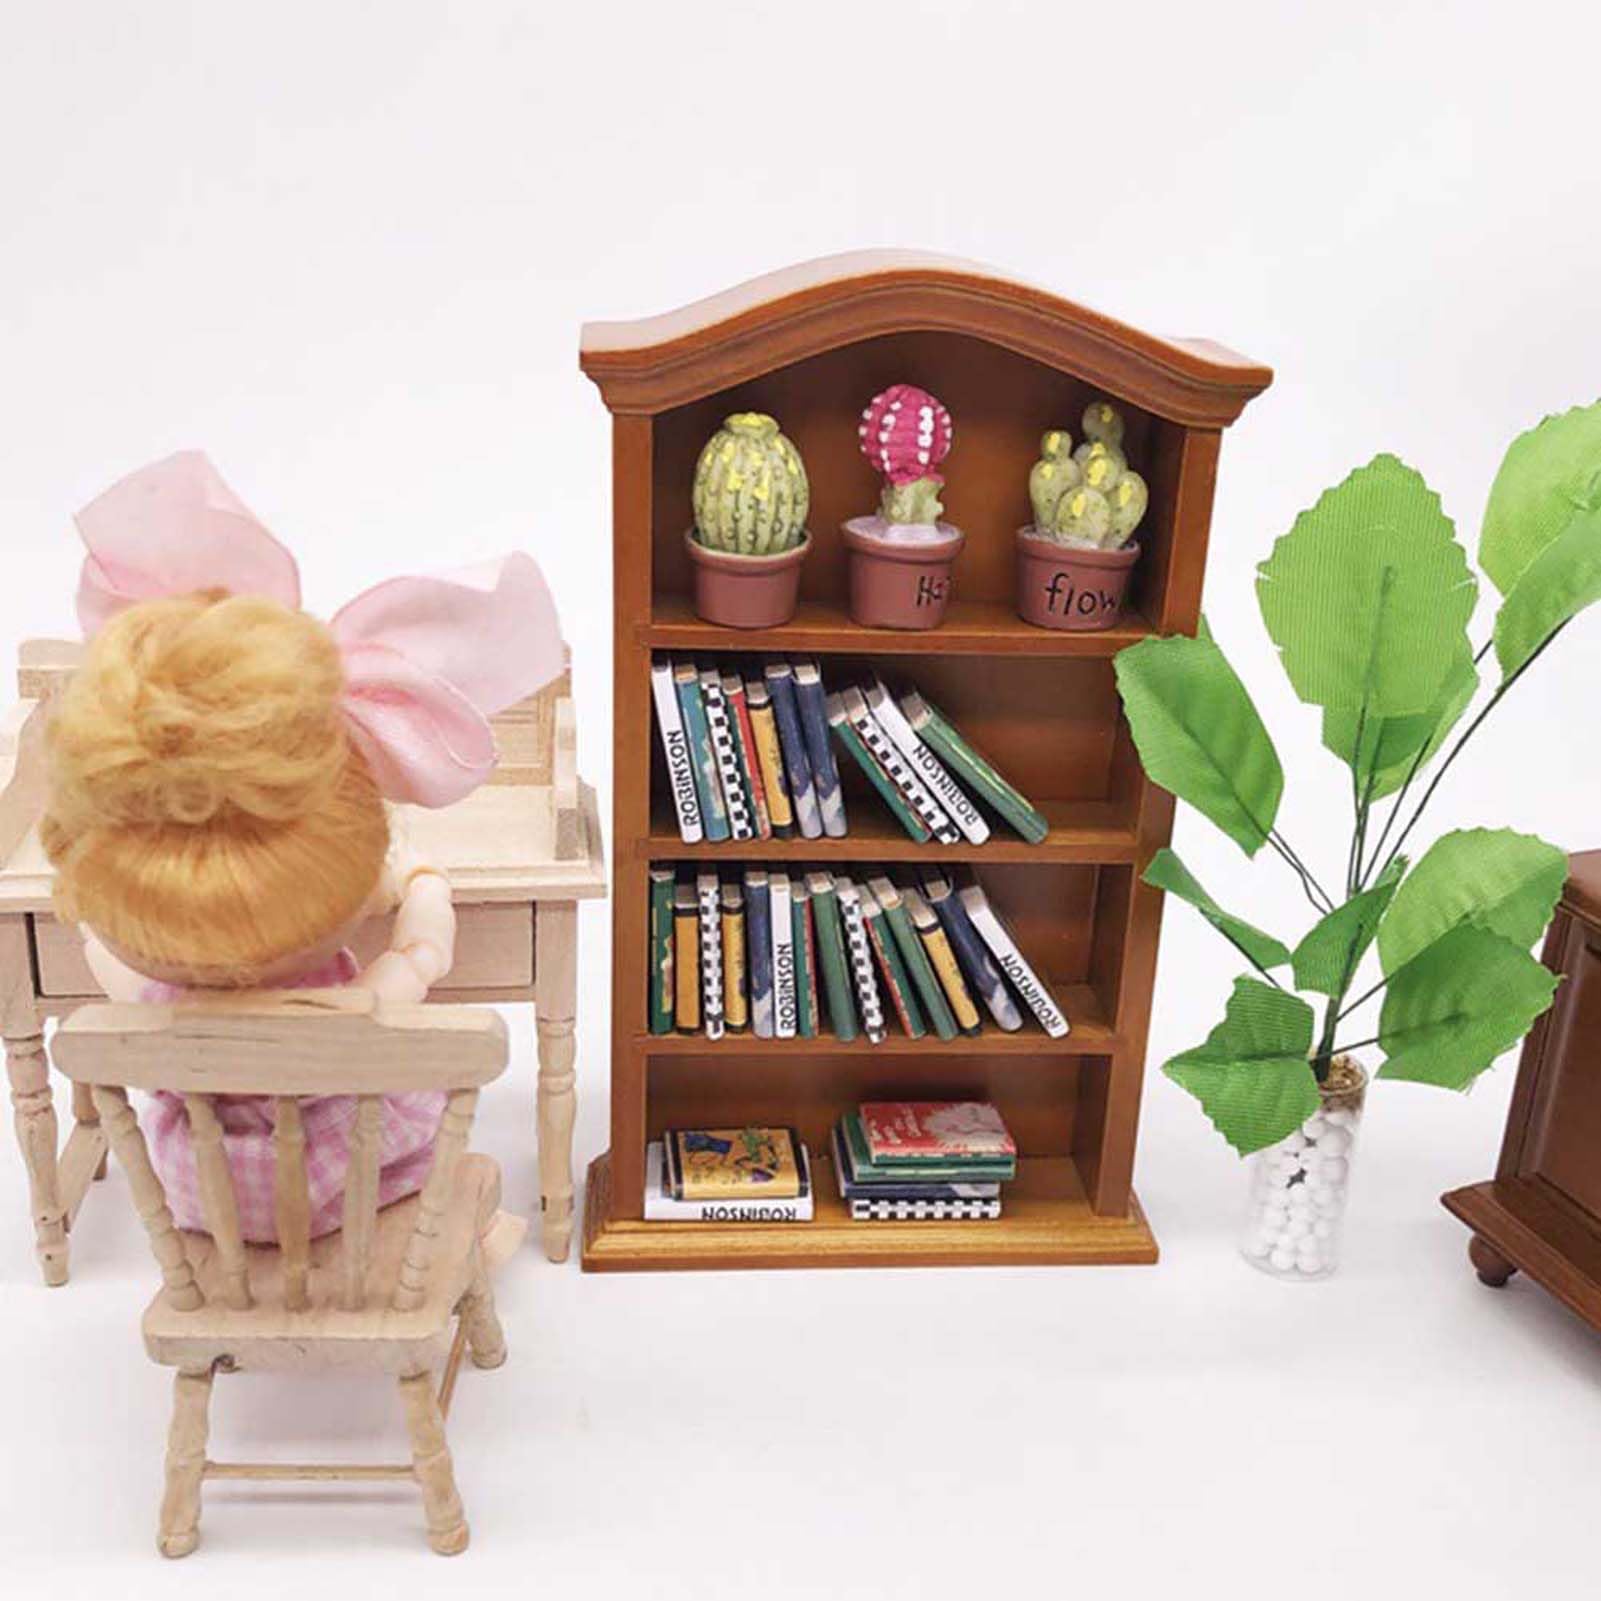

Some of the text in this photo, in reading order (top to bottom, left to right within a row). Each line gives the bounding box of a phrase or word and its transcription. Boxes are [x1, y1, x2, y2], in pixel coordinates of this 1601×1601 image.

[667, 730, 699, 826] ROBINSON
[913, 744, 978, 825] ROBINSON
[777, 944, 795, 1030] ROBINSON
[1001, 954, 1062, 1029] ROBINSON
[701, 1206, 797, 1223] ROBINSON
